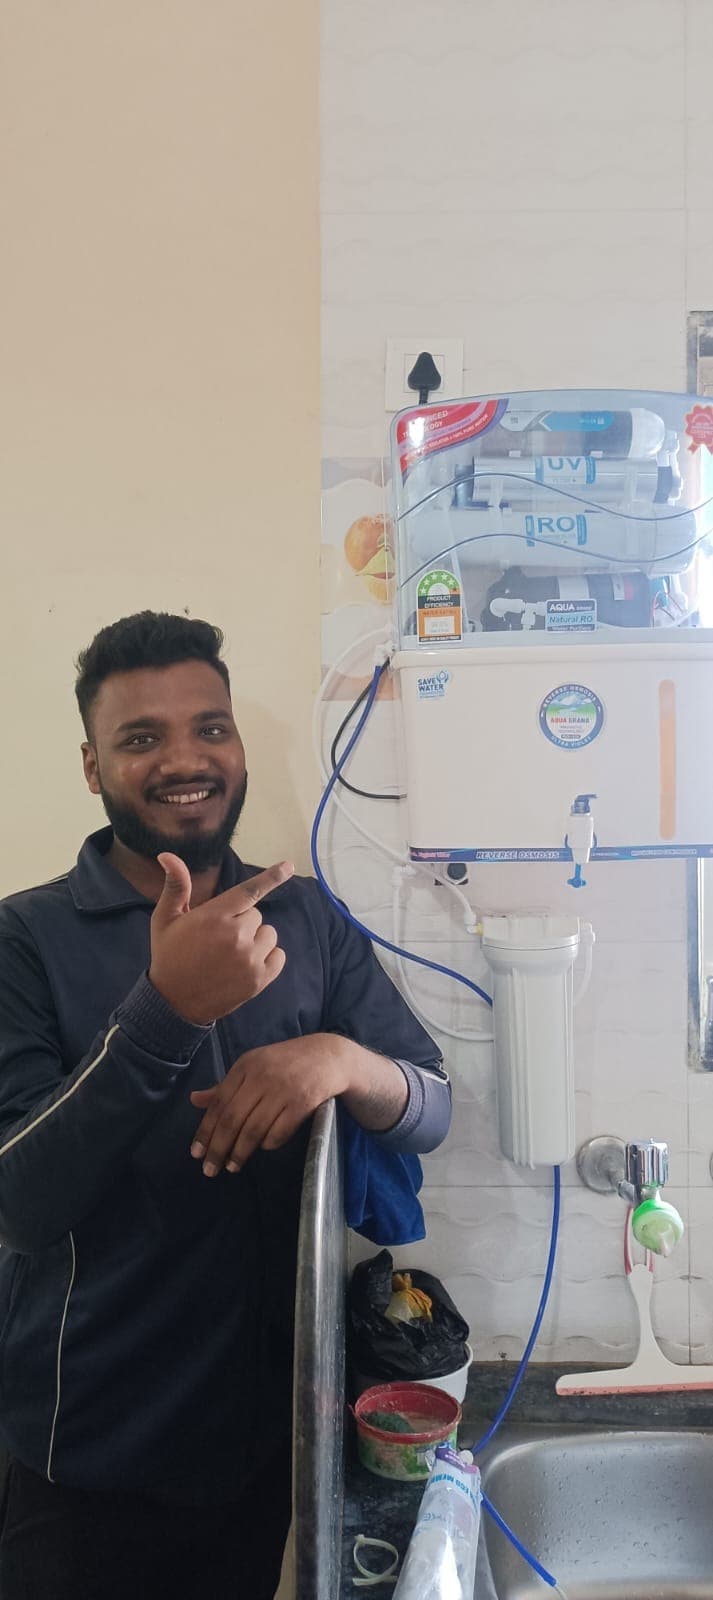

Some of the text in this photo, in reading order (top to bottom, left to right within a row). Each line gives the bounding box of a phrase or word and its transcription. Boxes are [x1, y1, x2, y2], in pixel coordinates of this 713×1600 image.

[547, 456, 581, 471] UV
[537, 516, 575, 534] RO
[550, 603, 575, 612] AQUA
[549, 615, 593, 624] Natural RO
[417, 677, 436, 686] SAVE
[418, 684, 444, 692] WATER
[475, 850, 560, 860] REVERSE OSMOSIS
